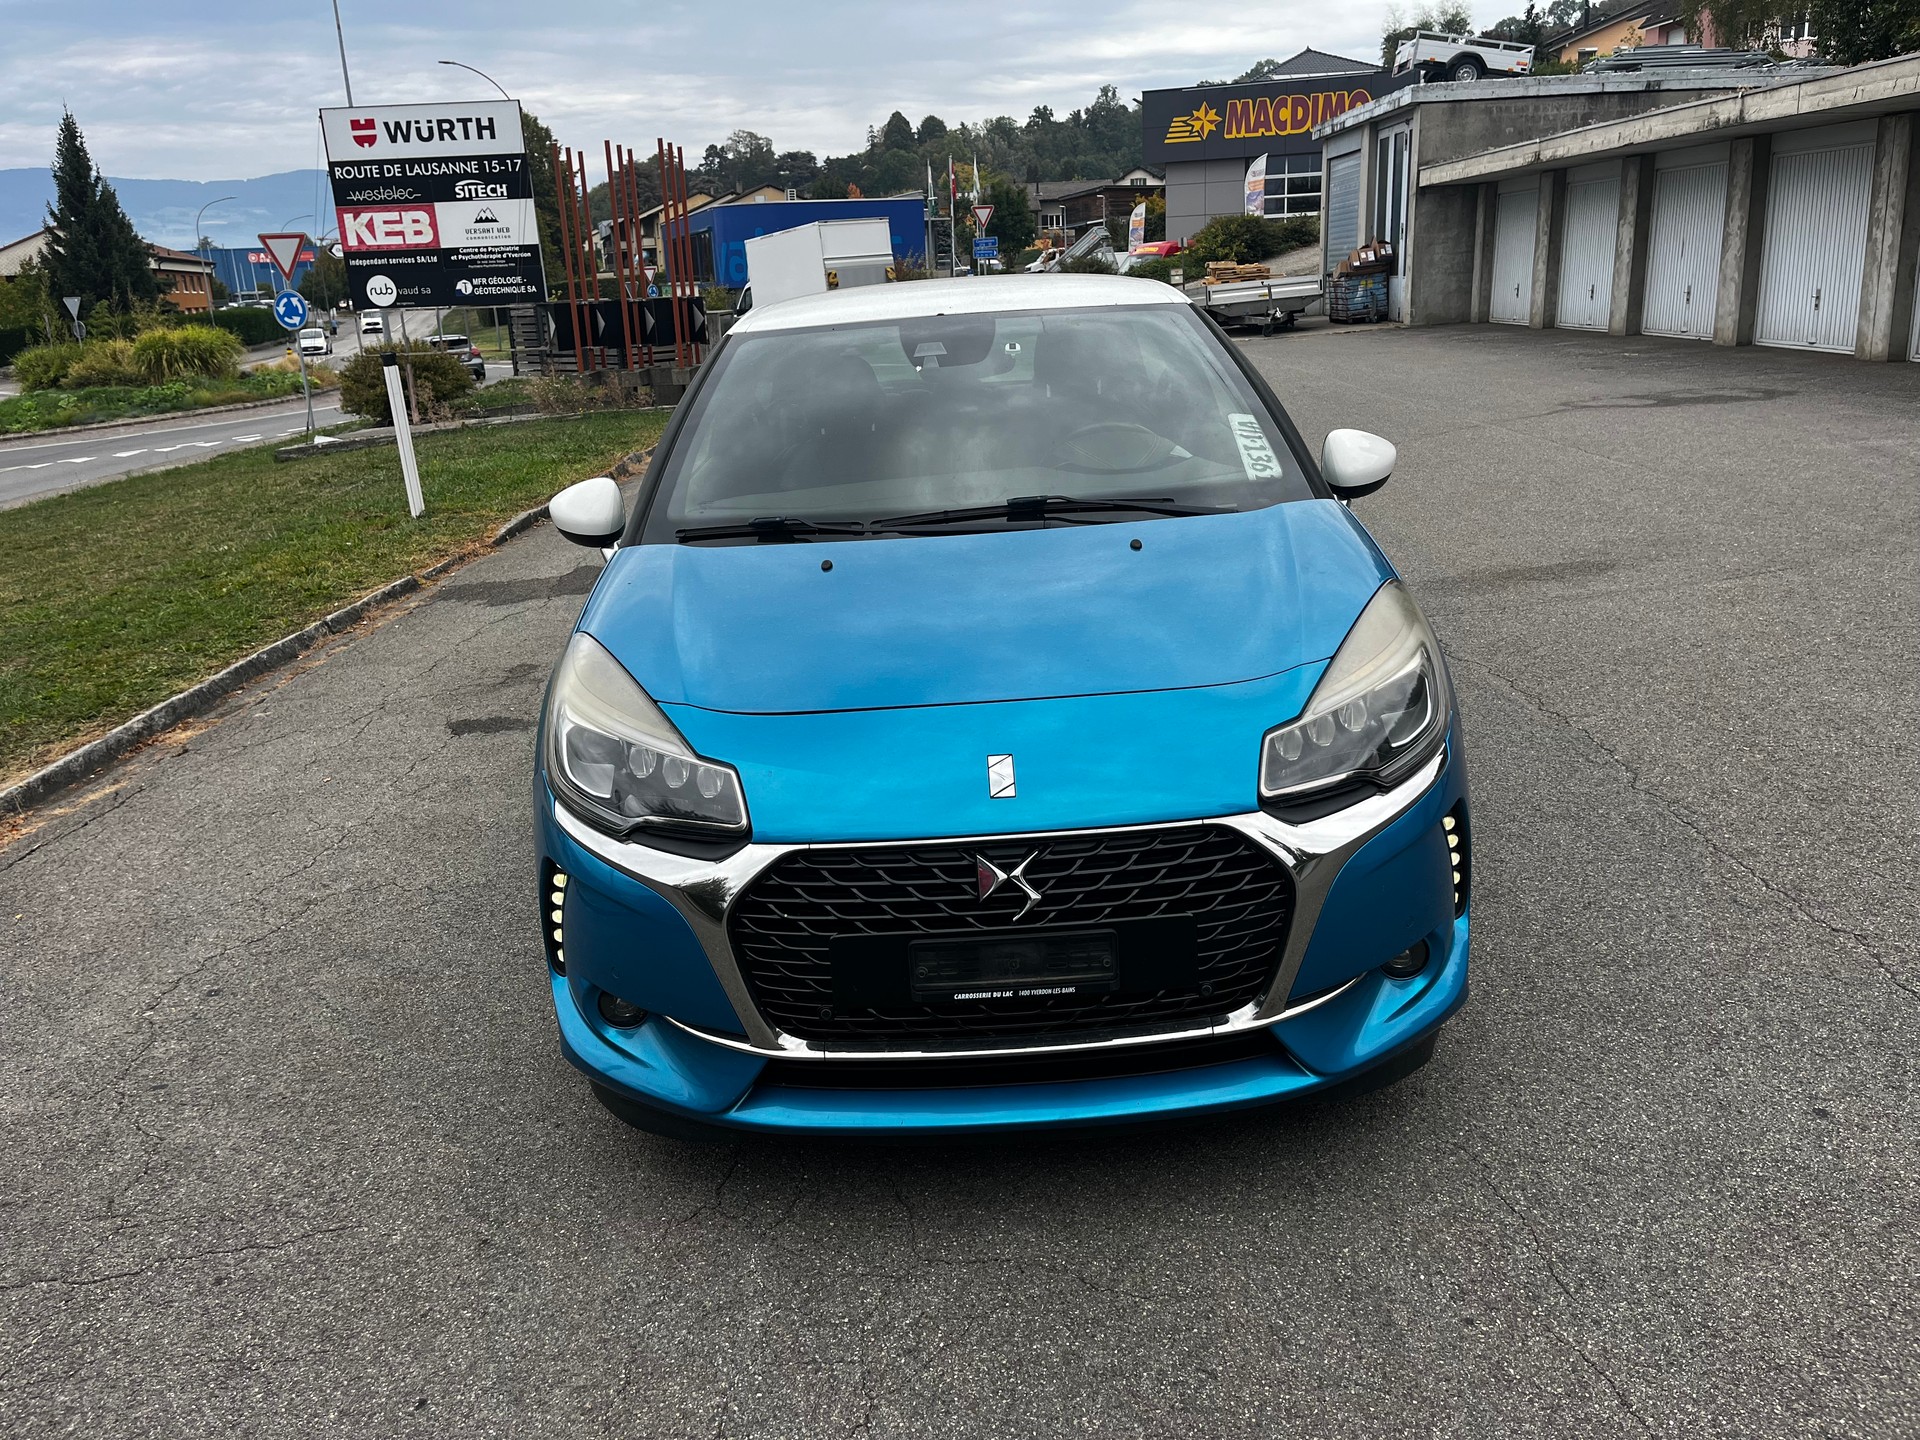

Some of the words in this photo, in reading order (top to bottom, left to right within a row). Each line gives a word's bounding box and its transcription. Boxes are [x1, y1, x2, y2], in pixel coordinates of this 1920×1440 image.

[383, 116, 496, 144] WÜRTH
[334, 165, 380, 180] ROUTE
[384, 163, 402, 177] DE
[405, 161, 479, 177] LAUSANNE
[483, 159, 522, 173] 15-17
[347, 185, 421, 201] westelec
[454, 183, 508, 200] SITECH
[343, 210, 434, 248] KEB
[465, 227, 494, 235] VERSANT
[496, 226, 510, 234] WEB
[488, 245, 519, 253] Psychiatrie
[416, 255, 438, 263] SA/Ltd
[458, 252, 501, 261] Psychothérapie
[488, 276, 522, 285] GÉOLOGIE
[398, 286, 418, 295] vaud
[421, 286, 431, 294] sa
[474, 285, 525, 295] GÉOTECHNIQUE
[527, 285, 537, 293] SA
[954, 992, 992, 1000] CARROSSERIE
